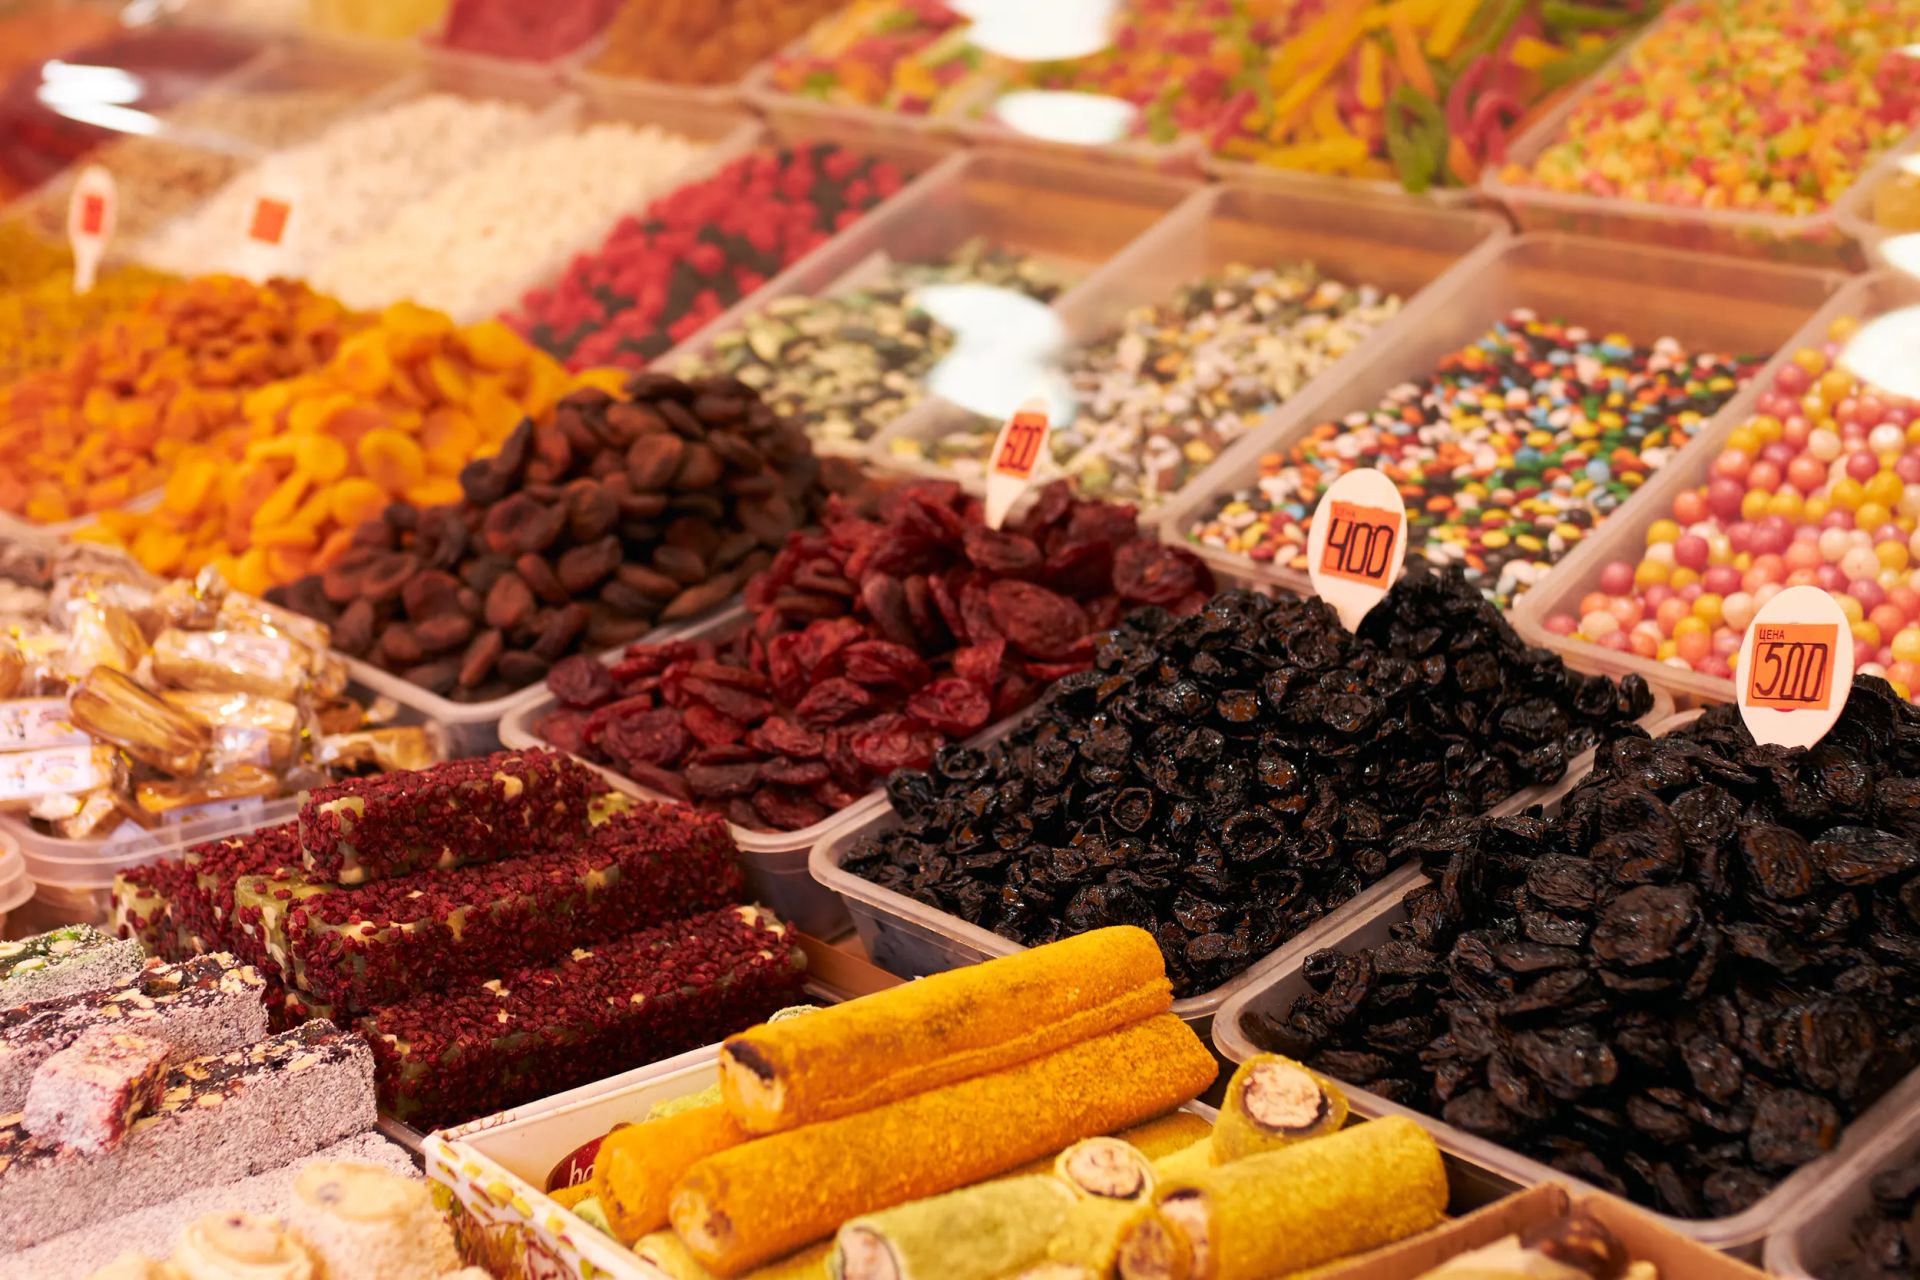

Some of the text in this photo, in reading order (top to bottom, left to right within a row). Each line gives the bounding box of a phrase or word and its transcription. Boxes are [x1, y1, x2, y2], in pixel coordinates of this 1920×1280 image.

[1327, 517, 1394, 579] 400
[1759, 629, 1785, 641] ЦЕНА
[1755, 641, 1828, 703] 500
